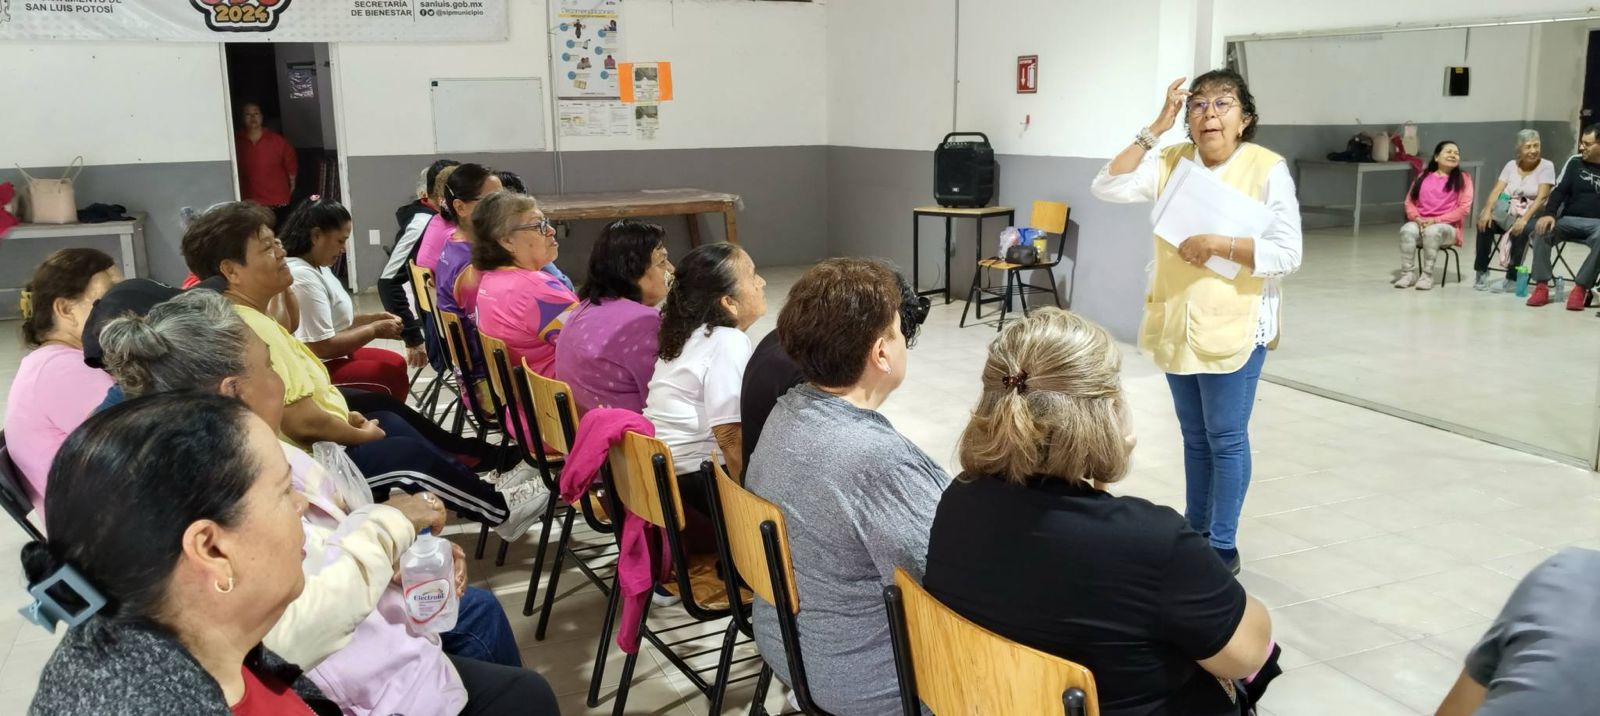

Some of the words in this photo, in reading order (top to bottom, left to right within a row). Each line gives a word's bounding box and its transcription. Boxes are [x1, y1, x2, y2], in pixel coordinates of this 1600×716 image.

[25, 3, 47, 12] SAN
[50, 4, 73, 12] LUIS
[76, 4, 114, 14] POTOSÍ
[420, 0, 483, 9] sanluis.gob.mx
[214, 5, 269, 22] 2024
[350, 9, 363, 17] DE
[365, 9, 413, 17] BIENESTAR
